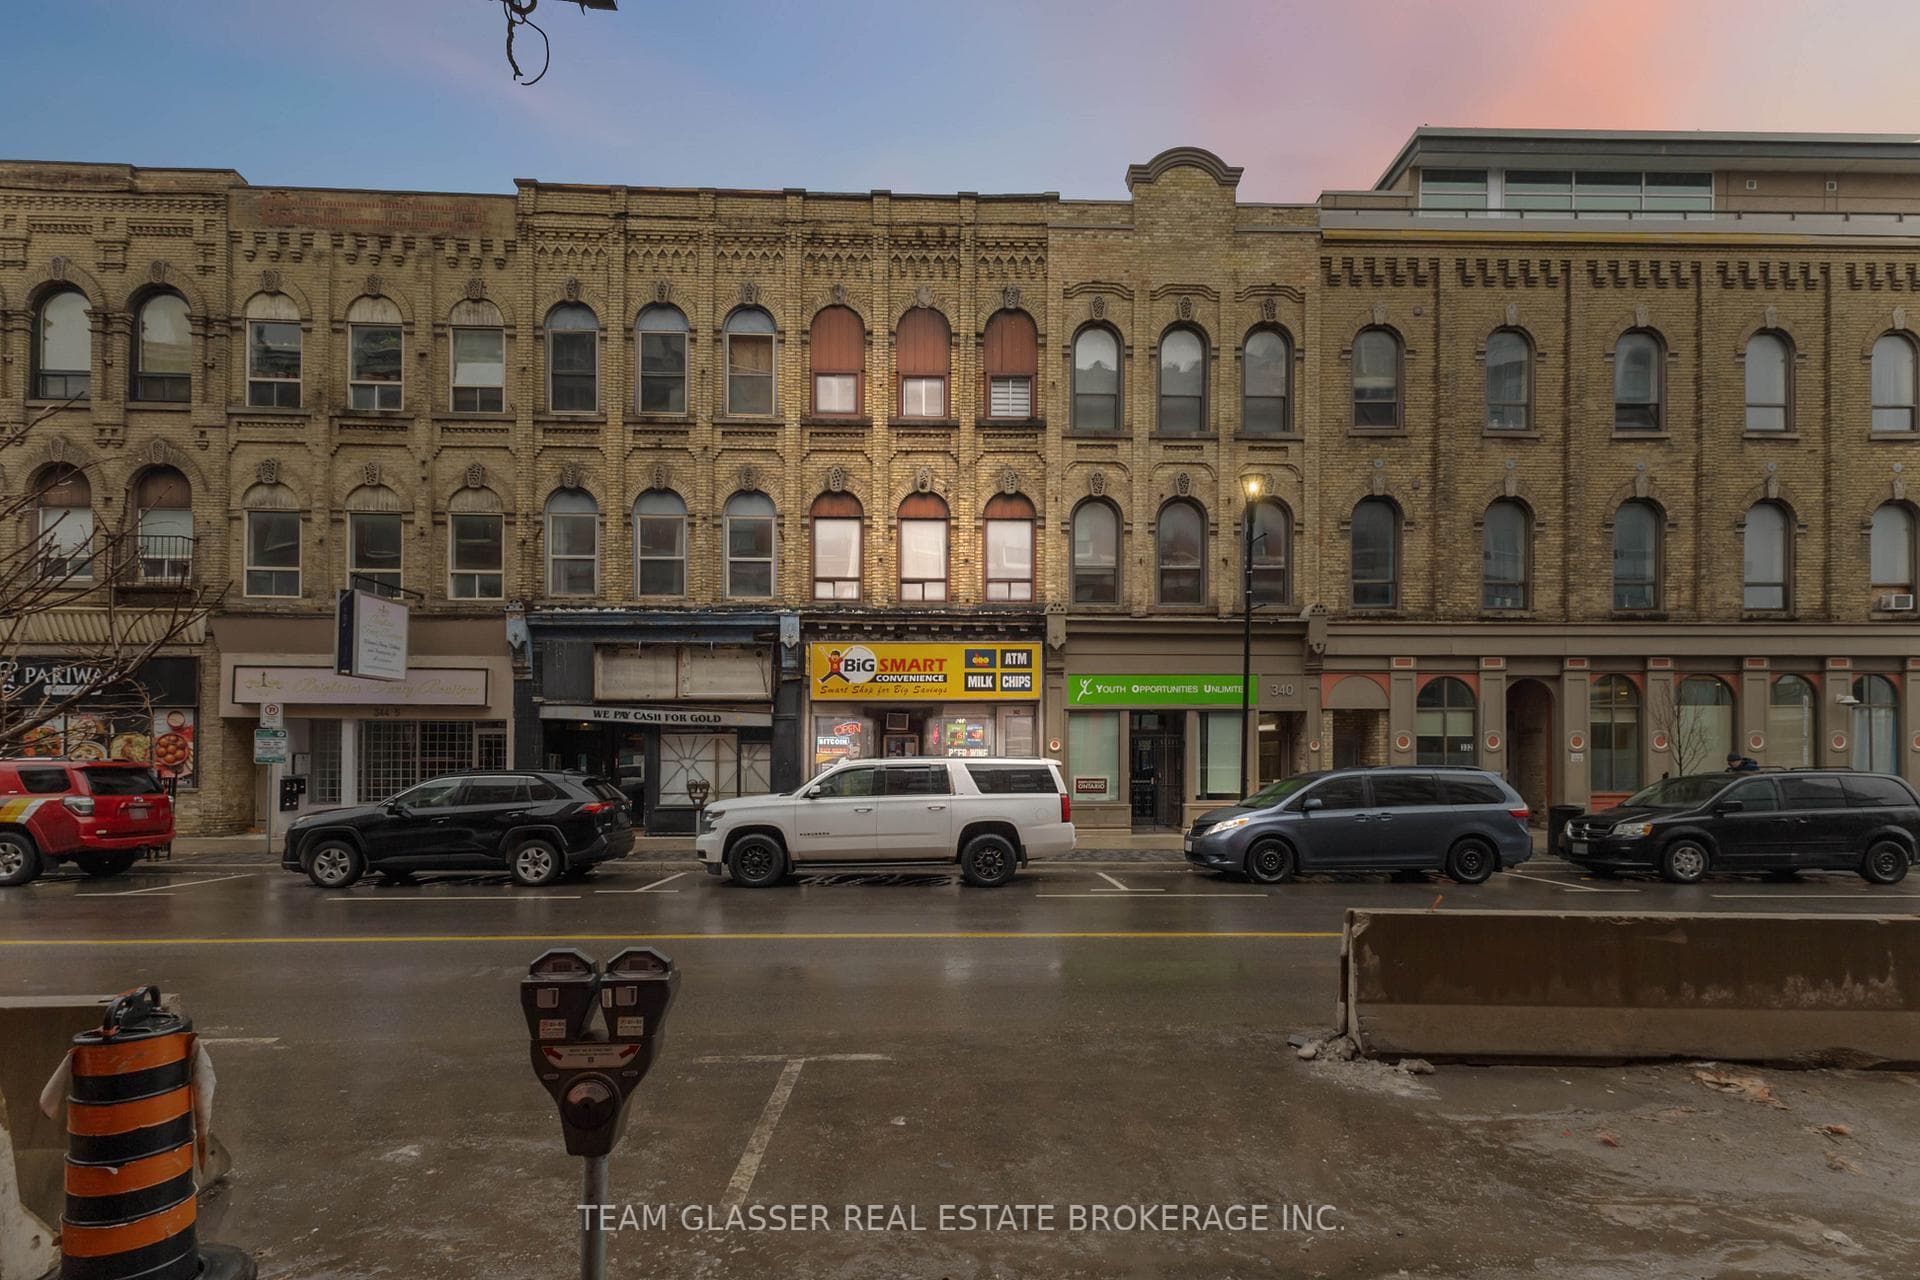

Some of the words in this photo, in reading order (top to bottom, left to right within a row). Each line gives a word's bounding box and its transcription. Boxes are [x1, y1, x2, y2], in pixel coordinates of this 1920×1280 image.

[844, 658, 875, 672] BiG
[880, 658, 947, 672] SMART
[1005, 652, 1028, 665] ATM
[876, 674, 944, 682] CONVENIENCE
[967, 675, 993, 688] MILK
[1002, 675, 1031, 688] CHIPS
[820, 685, 848, 694] Smart
[851, 685, 876, 696] Shop
[877, 686, 890, 696] for
[893, 685, 909, 695] Big
[913, 685, 948, 696] Savings
[1204, 684, 1246, 694] UNLIMITE
[1271, 683, 1294, 696] 340
[593, 710, 609, 718] WE
[614, 710, 631, 720] PAY
[633, 711, 661, 722] CASH
[665, 713, 687, 722] FOR
[690, 714, 721, 723] GOLD
[833, 723, 862, 735] OPEN
